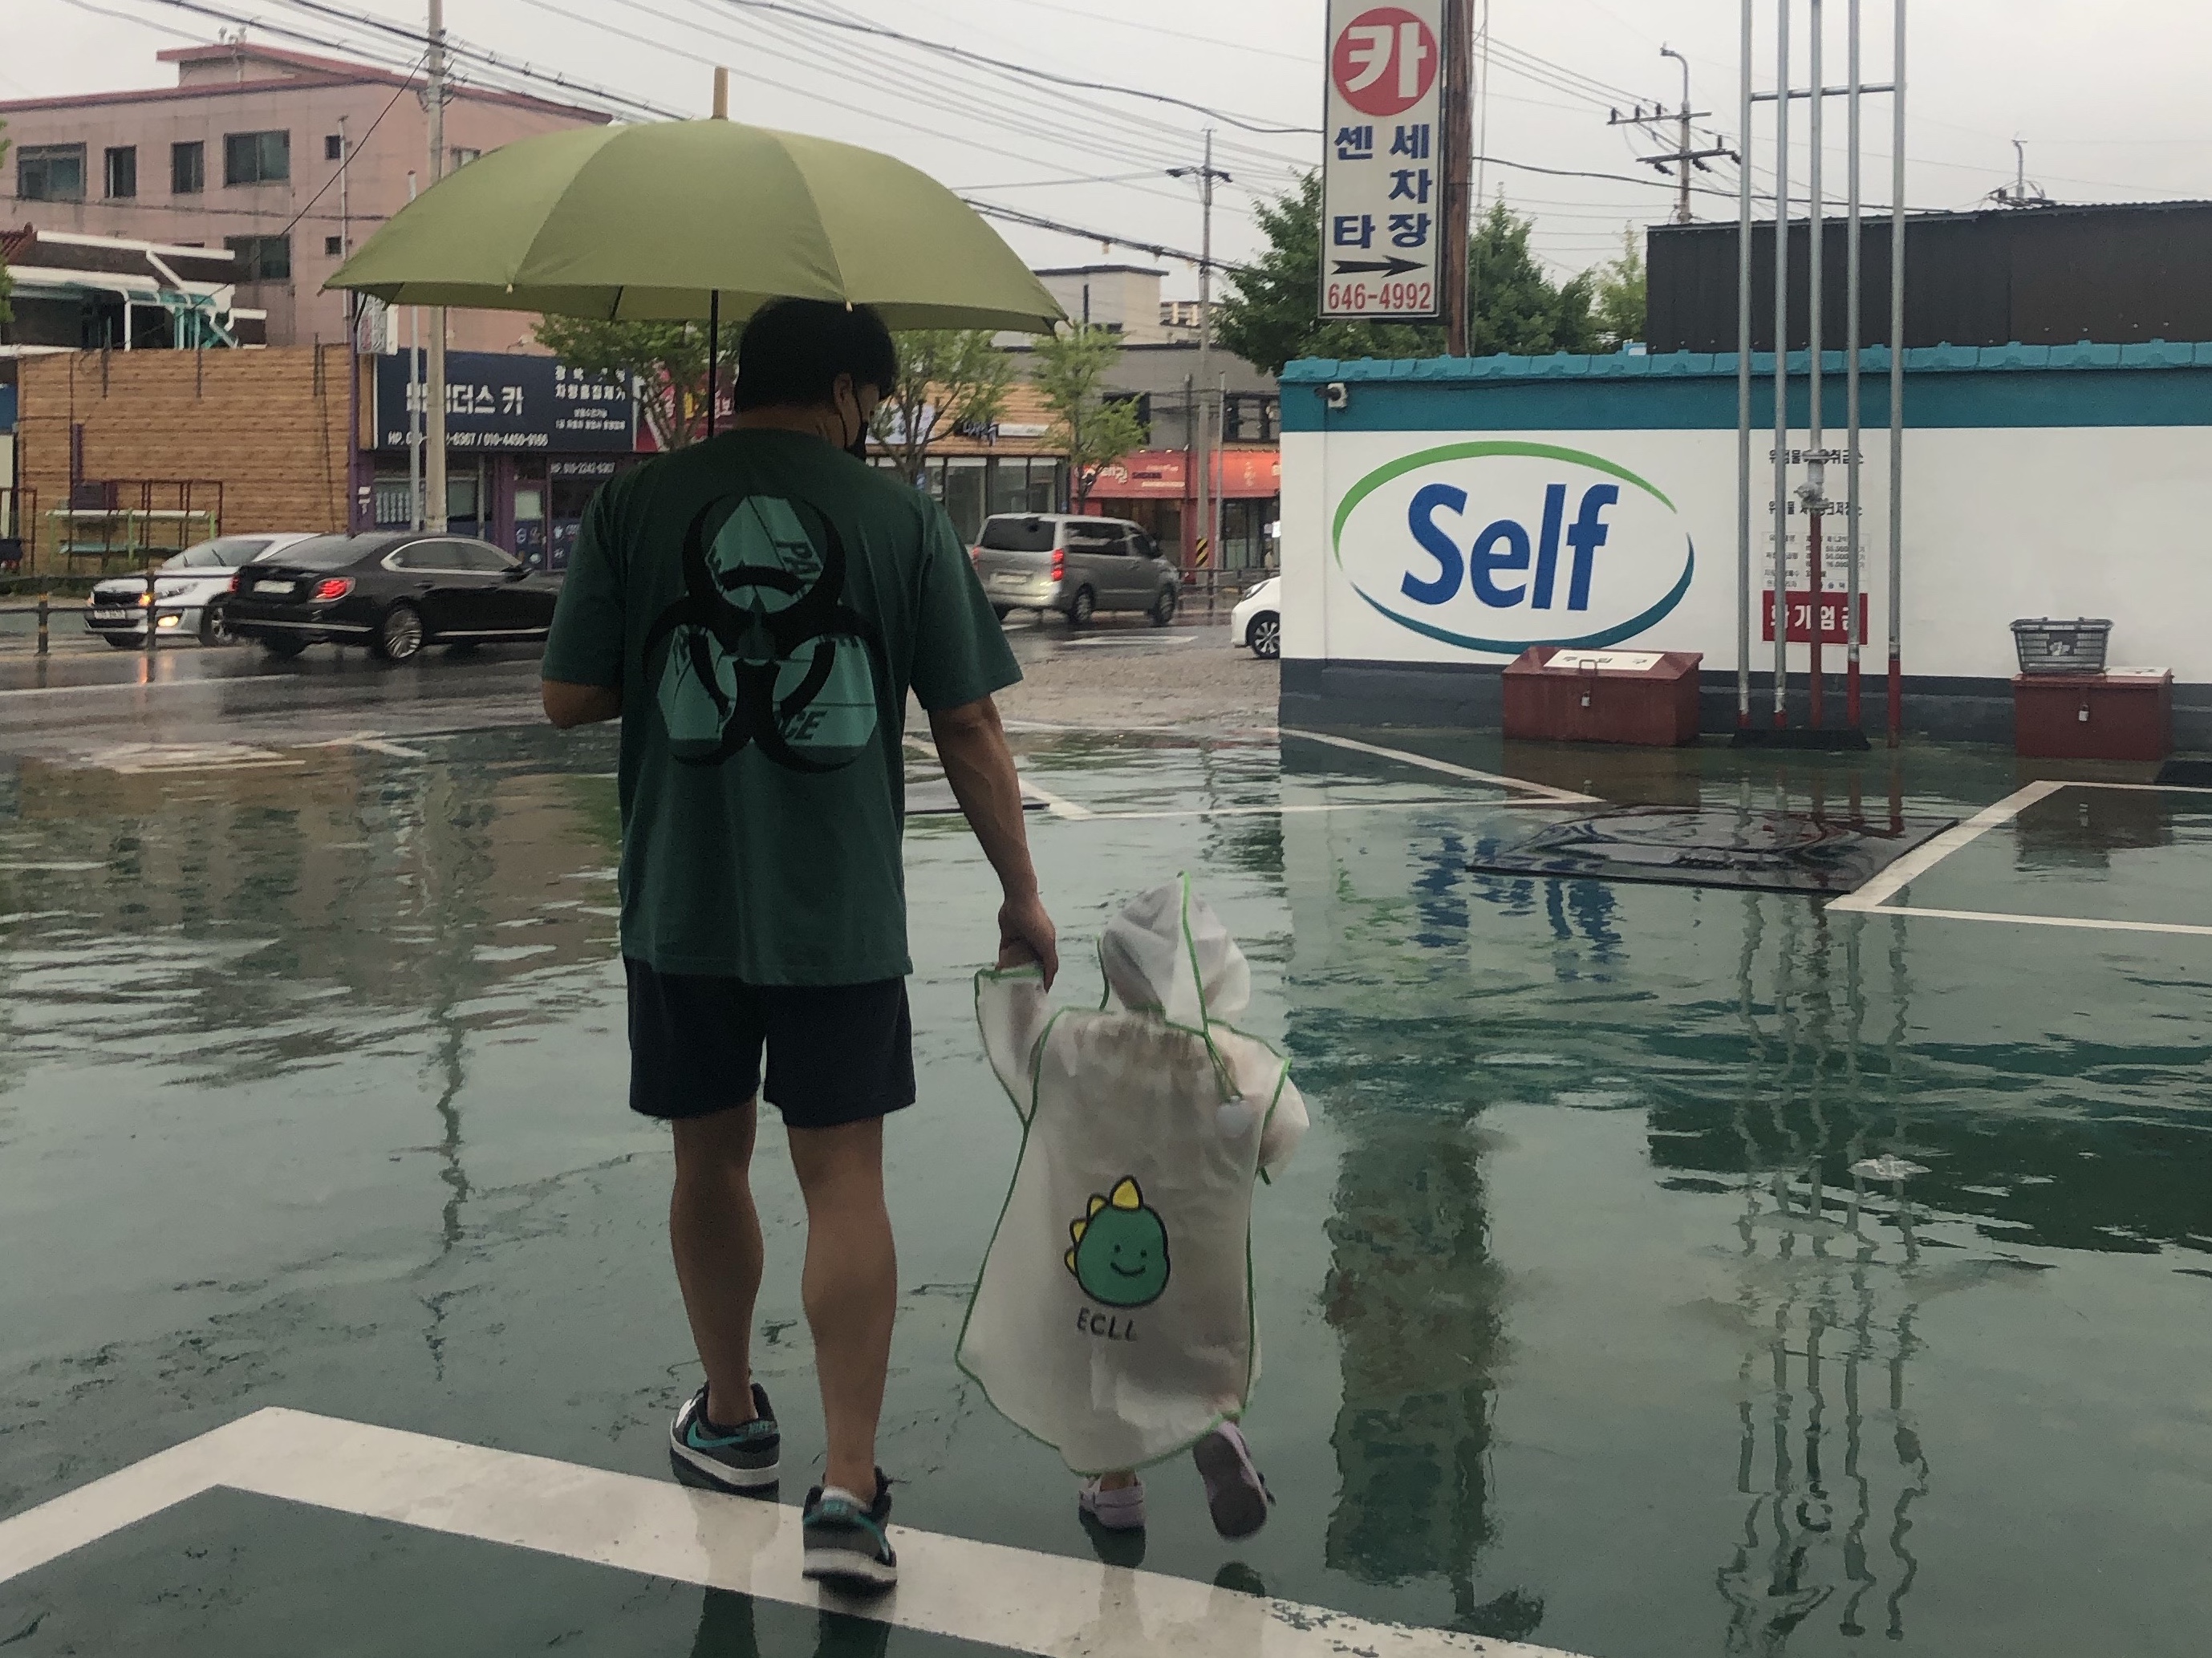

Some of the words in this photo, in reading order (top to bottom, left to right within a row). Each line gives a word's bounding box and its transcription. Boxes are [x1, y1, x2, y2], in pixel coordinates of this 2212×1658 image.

[1344, 22, 1428, 99] 카
[1328, 282, 1431, 310] 646-4992
[1399, 483, 1620, 612] Self
